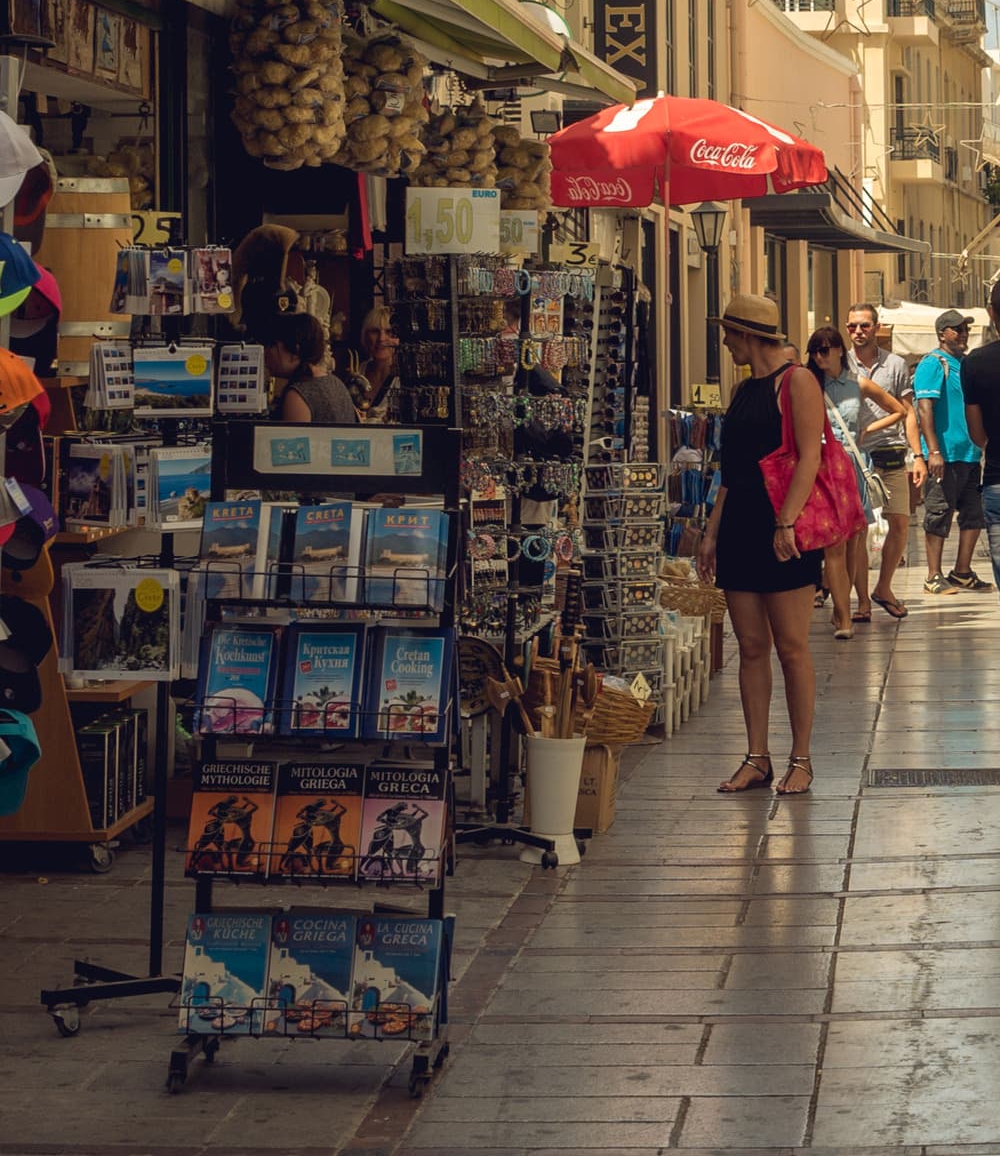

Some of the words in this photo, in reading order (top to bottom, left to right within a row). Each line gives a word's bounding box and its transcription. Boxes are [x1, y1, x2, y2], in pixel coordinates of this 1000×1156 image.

[690, 138, 760, 169] Coca-Cola
[472, 190, 498, 198] EURO
[408, 196, 474, 251] 1,50
[212, 506, 254, 519] KRETA
[306, 508, 345, 521] CRETA
[386, 514, 429, 526] КРИТ
[215, 645, 266, 664] Kochkunst
[303, 643, 350, 657] Критская
[396, 647, 430, 661] Cretan
[315, 656, 349, 673] Кухня
[391, 661, 433, 676] Cooking
[202, 763, 272, 775] GRIECHISCHE
[291, 766, 358, 778] MITOLOGIA
[201, 774, 270, 786] MYTHOLOGIE
[300, 778, 347, 790] GRIEGA
[371, 772, 440, 784] MITOLOGIA
[378, 782, 431, 794] GRECA
[207, 917, 264, 929] GRIECHISCHE
[293, 919, 347, 931] COCINA
[377, 923, 390, 933] LA
[395, 923, 433, 935] CUCINA
[293, 930, 347, 942] GRIEGA
[381, 933, 428, 945] GRECA
